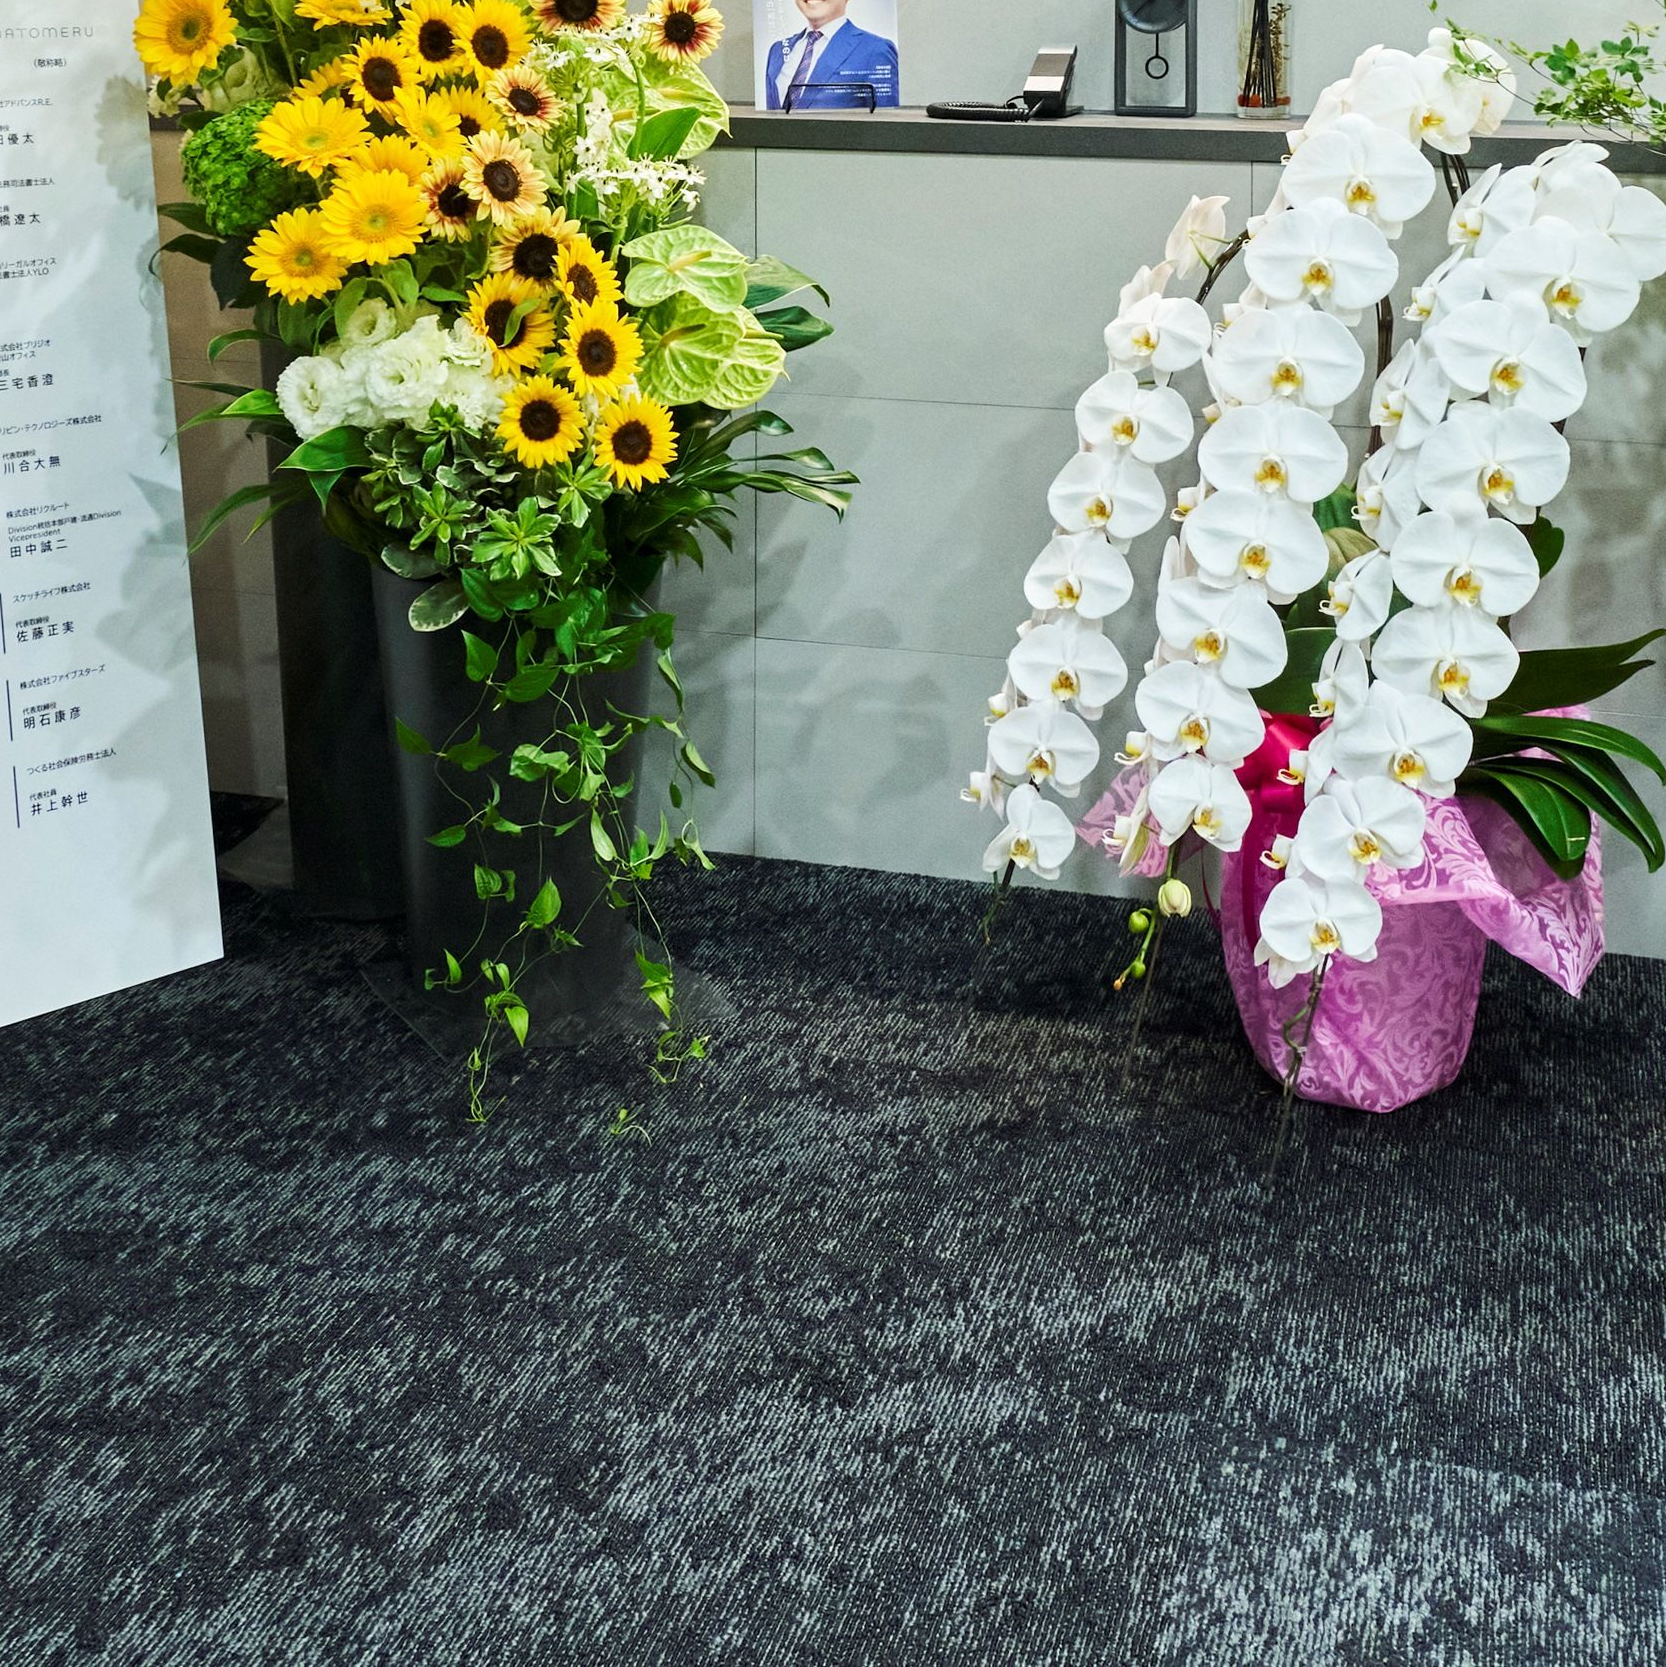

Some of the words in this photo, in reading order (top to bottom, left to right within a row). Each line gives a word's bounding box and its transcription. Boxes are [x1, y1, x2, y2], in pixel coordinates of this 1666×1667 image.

[2, 449, 36, 460] 代表取締役
[4, 456, 61, 474] 川合大無
[6, 502, 70, 519] 株式会社リクルート
[8, 528, 61, 543] Vicepresident
[10, 538, 68, 558] 田中誠二
[13, 582, 91, 604] スケッチライフ株式会社
[16, 615, 49, 628] 代表取締役
[17, 621, 74, 643] 佐藤正実
[20, 664, 106, 690] 株式会社ファイブスターズ
[23, 702, 57, 716] 代表取締役
[23, 706, 81, 730] 明石康彦
[27, 747, 117, 775] つくる社会保険労務士法人
[29, 788, 57, 801] 代表社員
[31, 791, 88, 816] 井上幹世
